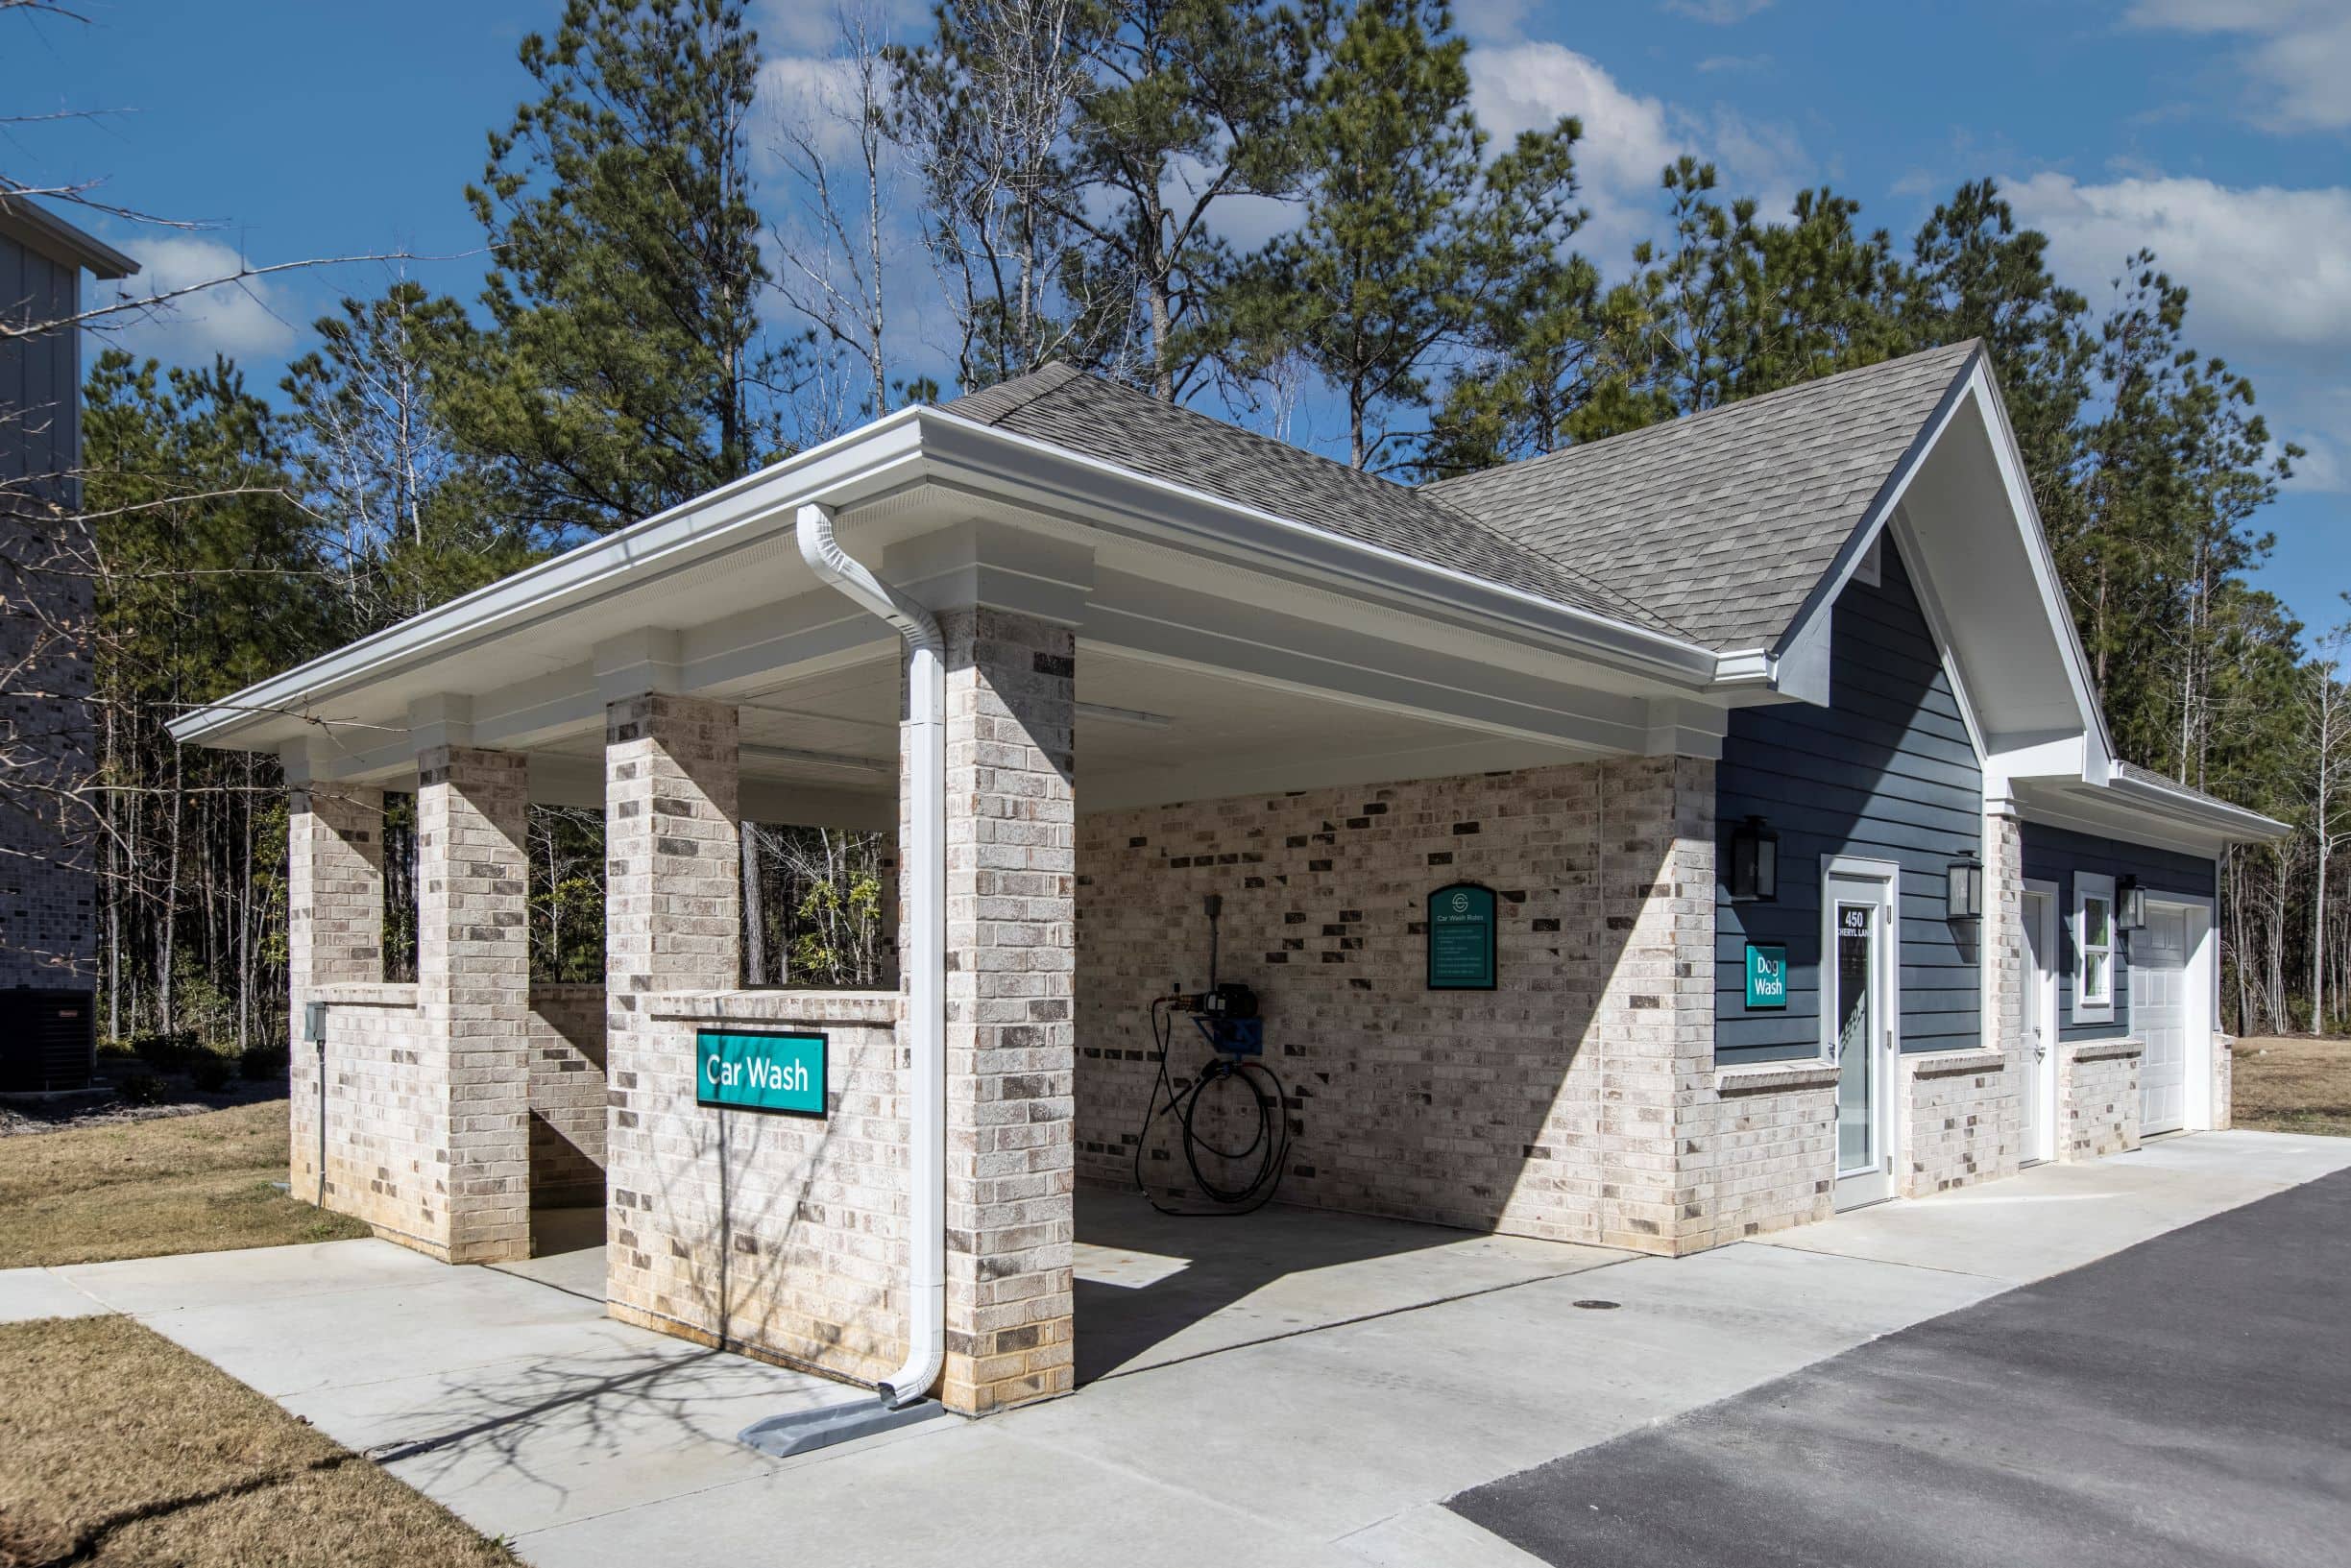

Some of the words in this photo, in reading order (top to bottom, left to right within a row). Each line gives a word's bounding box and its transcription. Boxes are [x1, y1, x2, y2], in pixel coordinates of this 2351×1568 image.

[1845, 911, 1863, 928] 450
[1757, 956, 1779, 977] Dog
[1755, 977, 1782, 996] Wash
[706, 1053, 742, 1086] Car
[746, 1056, 809, 1092] Wash
